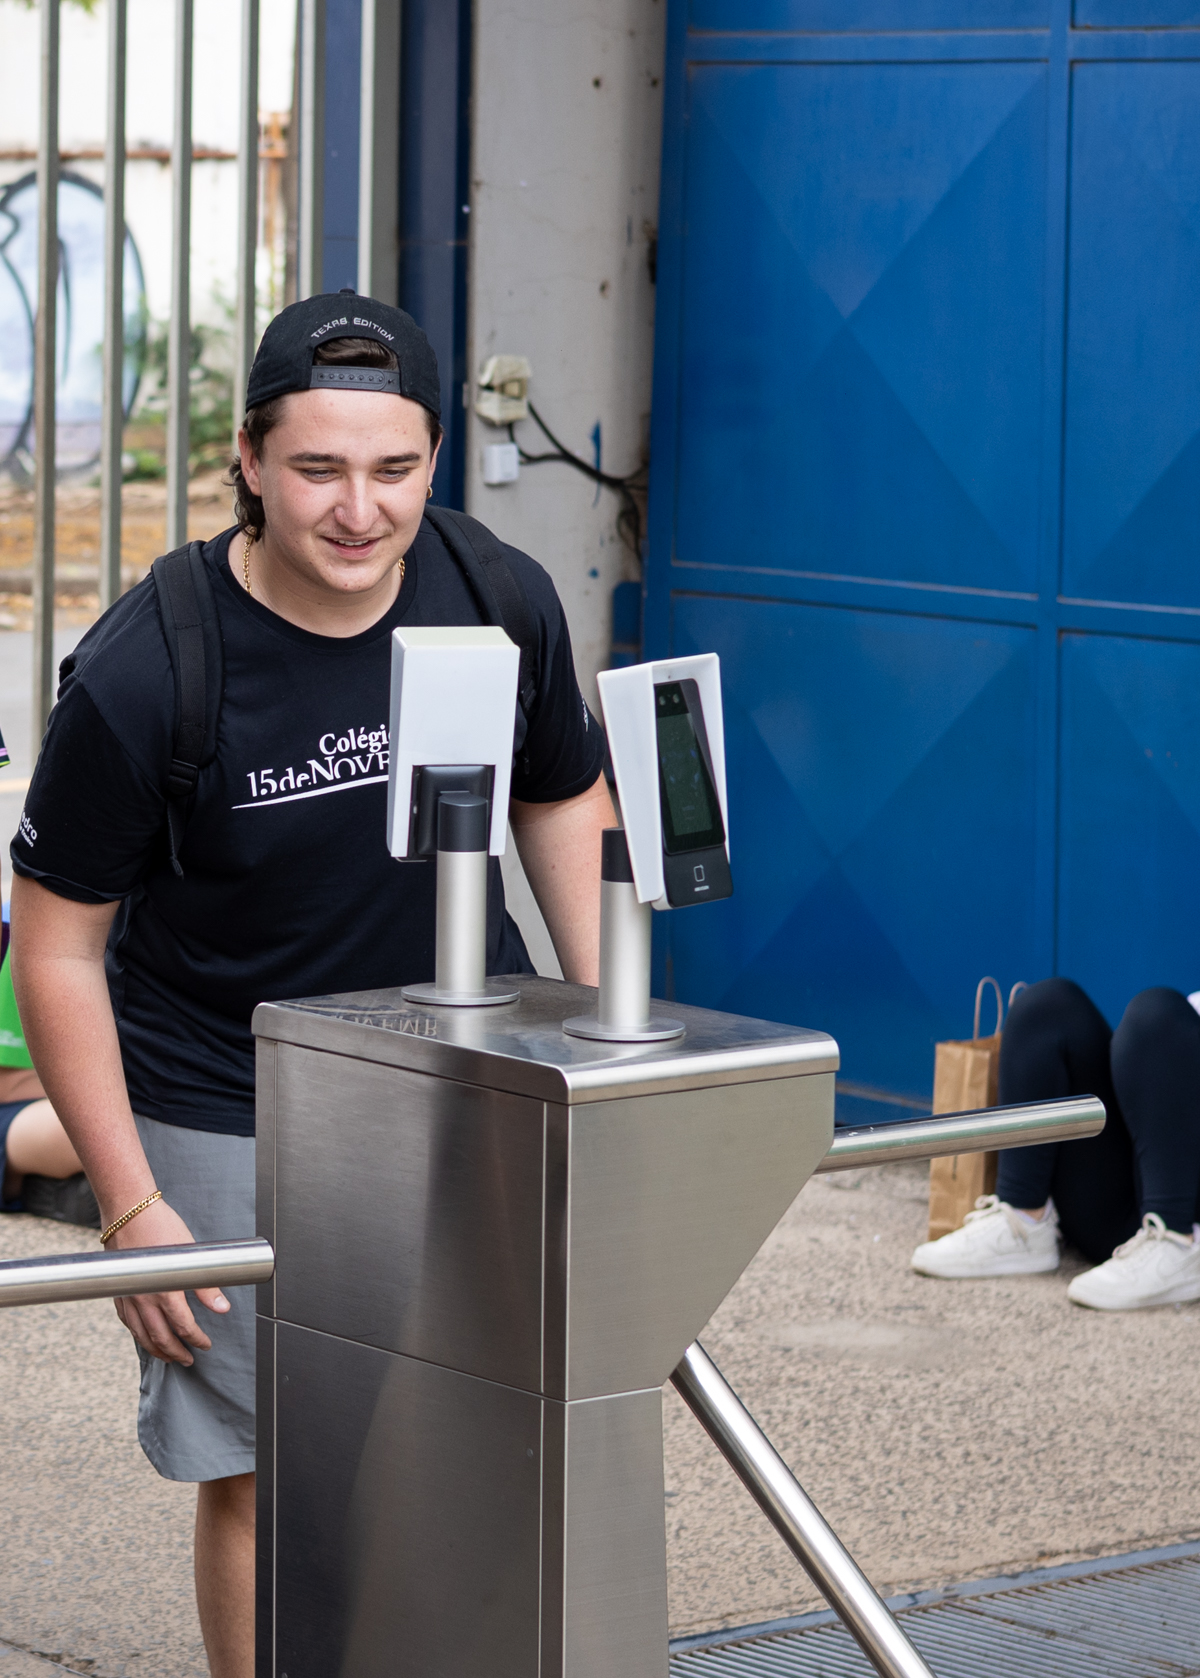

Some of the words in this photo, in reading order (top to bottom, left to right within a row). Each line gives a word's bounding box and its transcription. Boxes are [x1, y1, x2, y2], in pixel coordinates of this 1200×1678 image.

[311, 317, 348, 339] TEXAS
[353, 317, 395, 341] EDITION
[318, 724, 391, 755] Colégi
